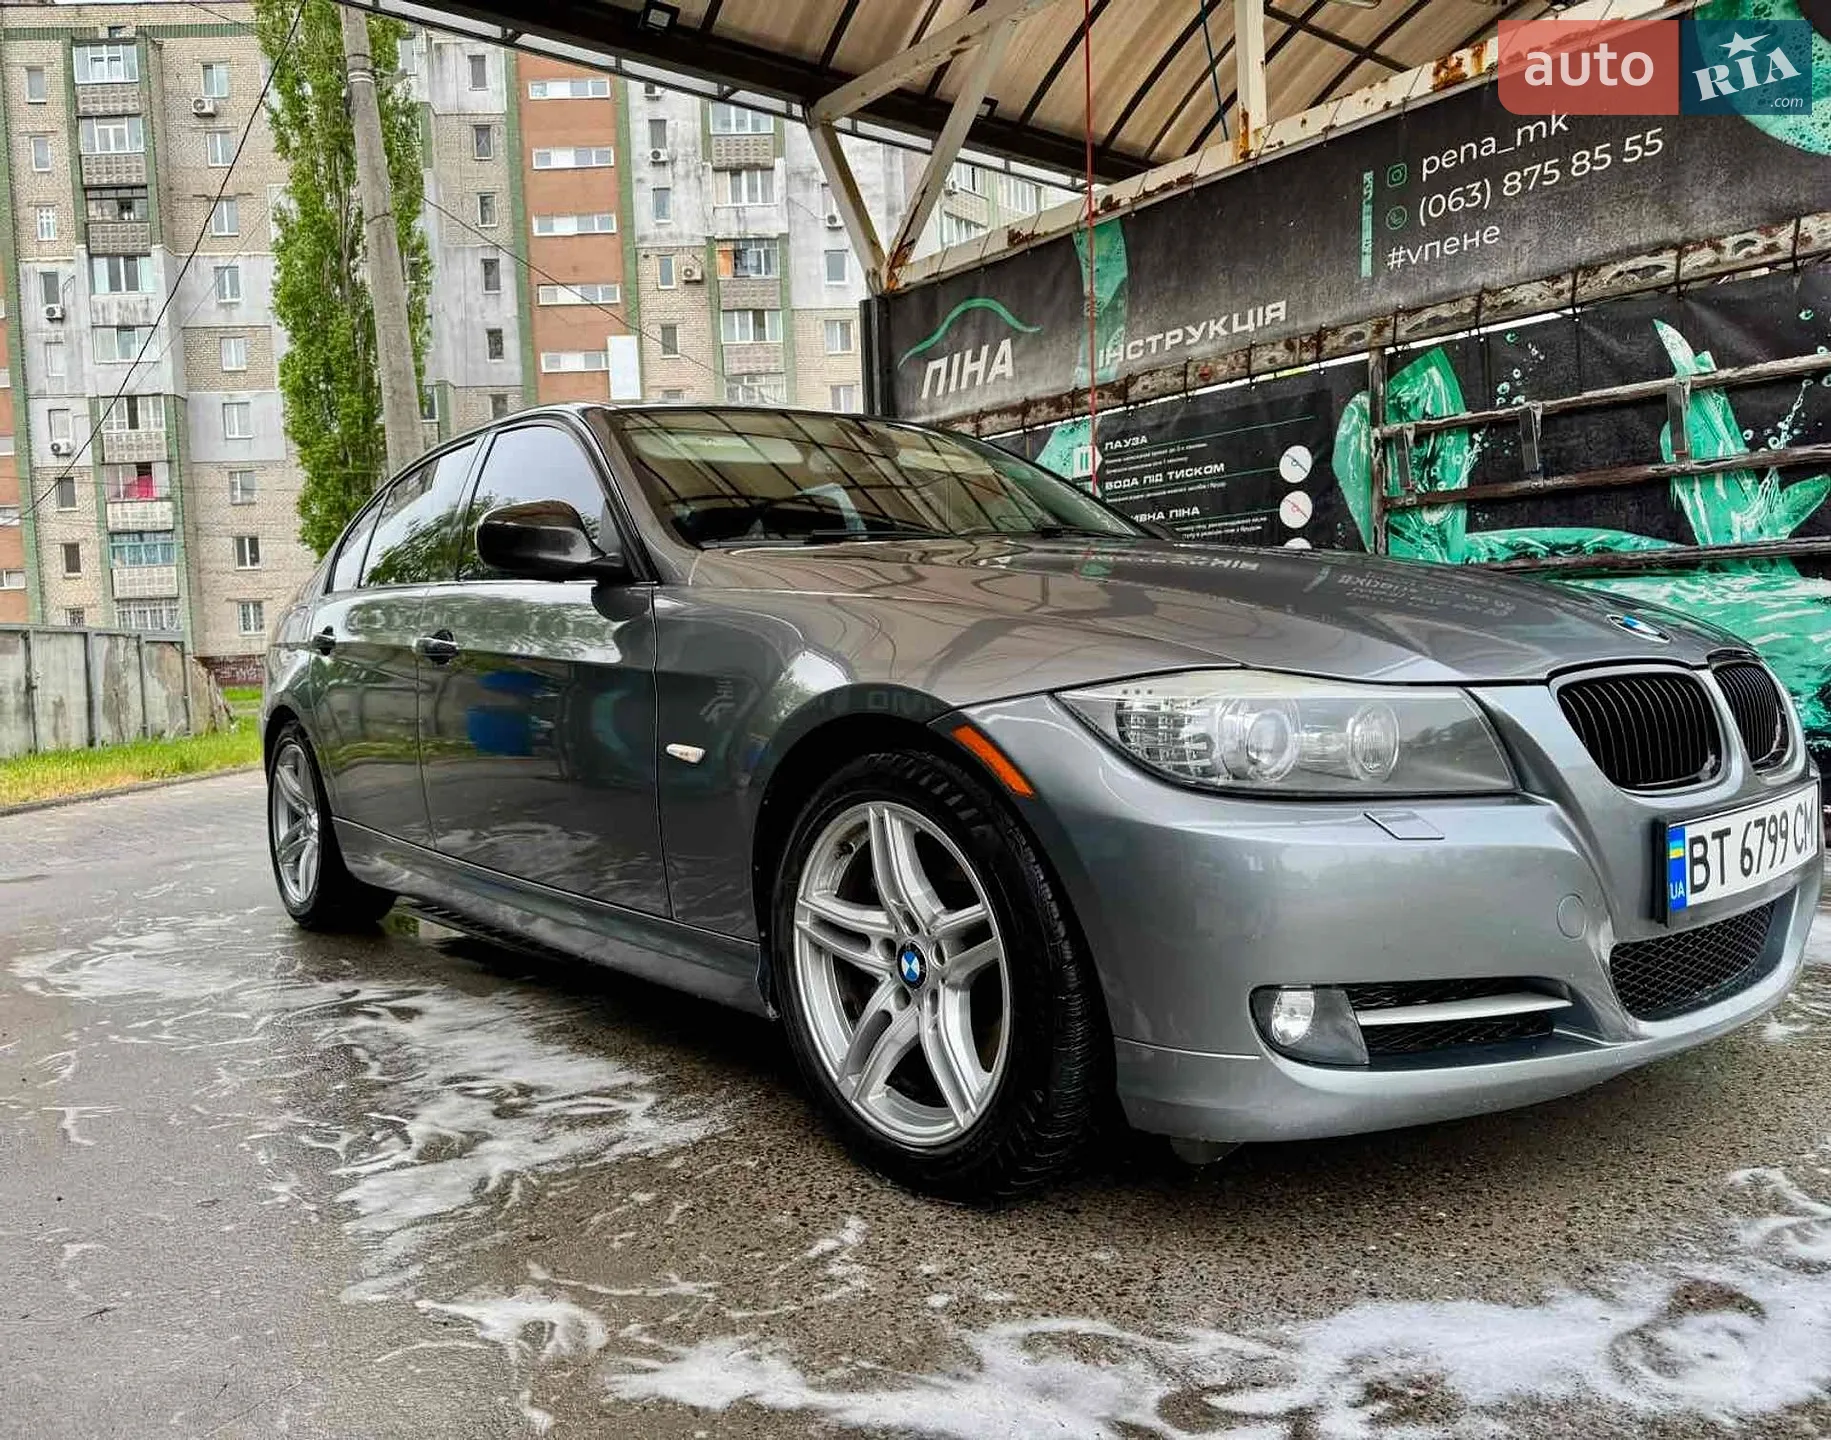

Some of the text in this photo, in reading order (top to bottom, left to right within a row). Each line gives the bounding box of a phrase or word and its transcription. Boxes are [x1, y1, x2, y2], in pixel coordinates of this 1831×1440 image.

[1422, 110, 1569, 182] pena_mk
[1420, 128, 1664, 227] (063) 875 85 55
[1098, 300, 1287, 368] ІНСТРУКЦІЯ
[921, 338, 1014, 400] ПІНА
[1104, 435, 1148, 451] ПАУЗА
[1104, 477, 1140, 491] ВОДА
[1142, 472, 1164, 485] ПІД
[1167, 462, 1226, 481] ТИСКОМ
[1168, 506, 1201, 519] ПІНА
[1688, 797, 1815, 896] BT 6799 CM
[1669, 881, 1686, 900] UA
